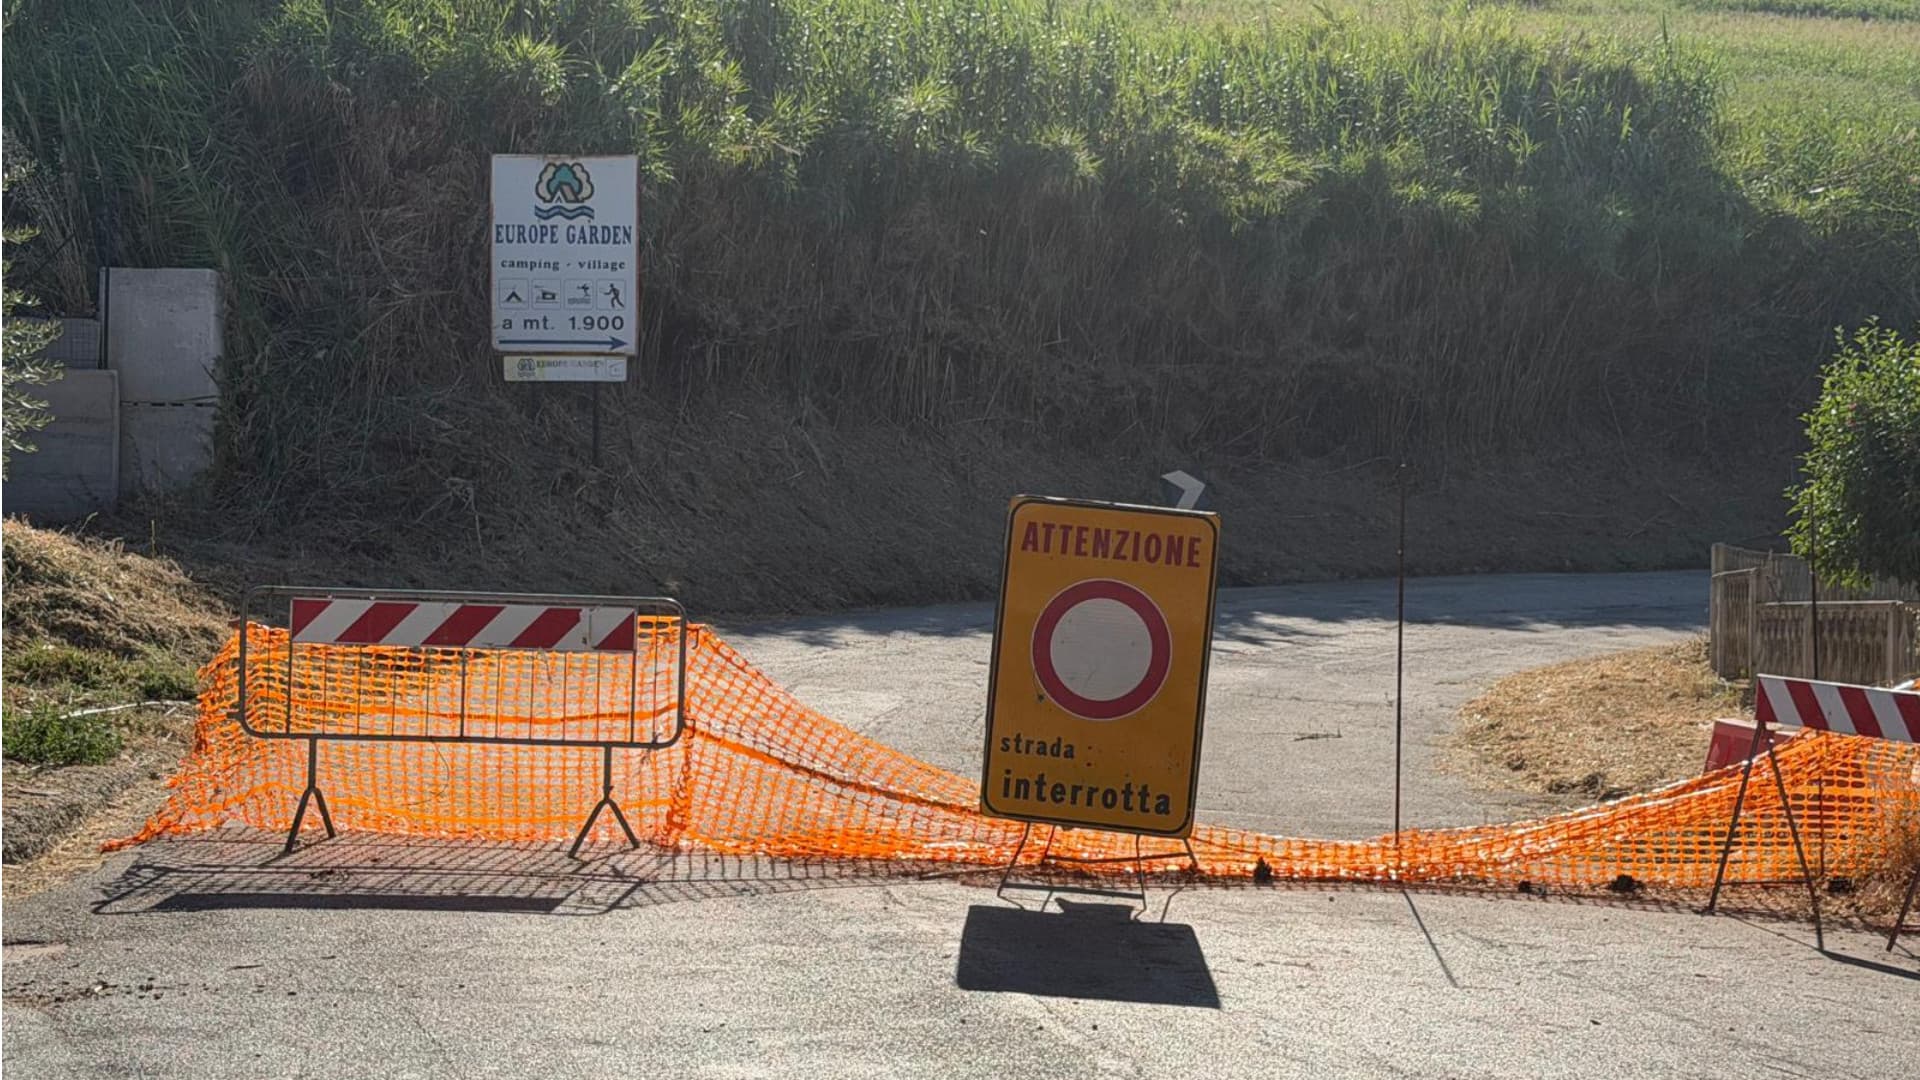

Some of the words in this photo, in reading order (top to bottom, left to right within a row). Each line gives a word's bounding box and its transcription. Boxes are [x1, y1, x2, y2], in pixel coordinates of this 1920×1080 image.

[495, 224, 558, 244] EUROPE
[566, 225, 632, 245] GARDEN
[501, 259, 560, 272] camping
[578, 259, 625, 272] village
[502, 317, 513, 330] a
[523, 315, 554, 330] mt.
[568, 315, 625, 331] 1.900
[1021, 521, 1202, 568] ATTENZIONE
[1000, 732, 1075, 759] strada
[1002, 769, 1171, 816] interrotta
